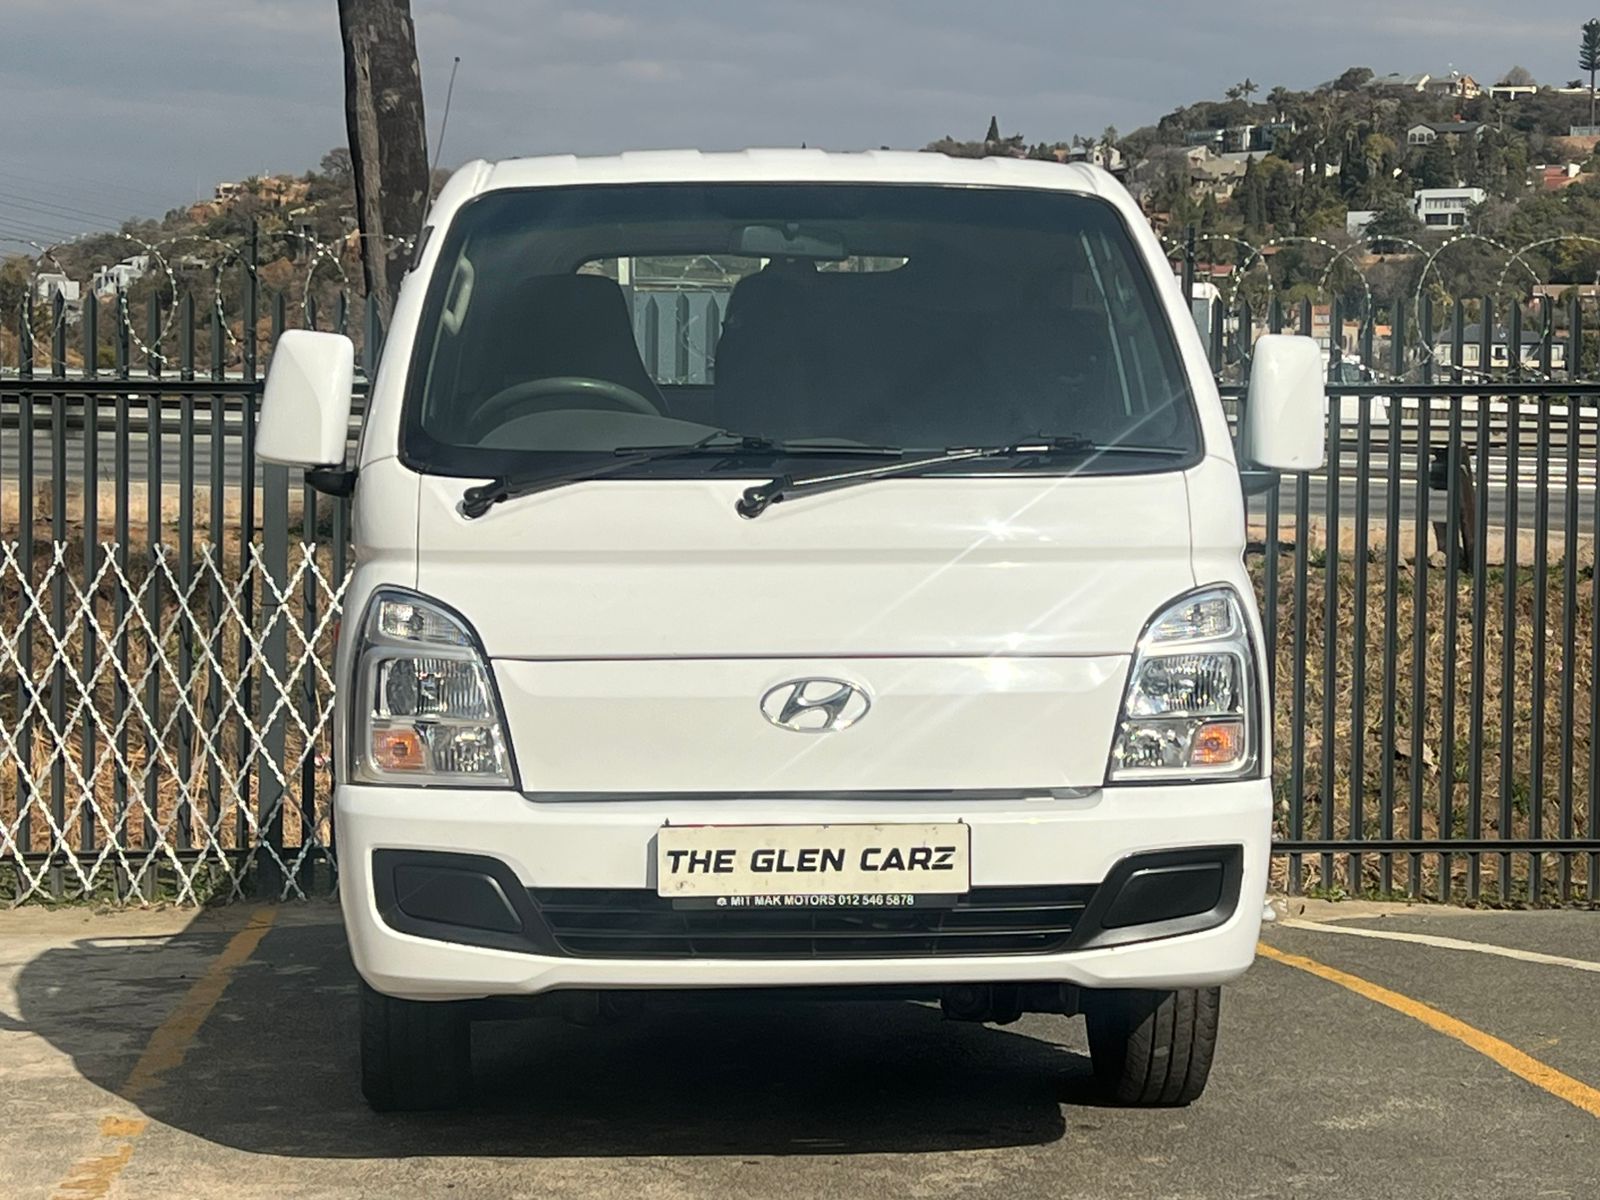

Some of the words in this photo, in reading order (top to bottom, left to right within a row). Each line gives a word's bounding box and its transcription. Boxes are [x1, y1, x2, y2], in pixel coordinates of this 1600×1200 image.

[667, 849, 736, 873] THE
[750, 848, 845, 873] GLEN
[860, 846, 956, 871] CARZ
[730, 896, 751, 906] MIT
[754, 896, 782, 906] MAK
[784, 895, 836, 905] MOTORS
[838, 894, 860, 905] 012
[862, 894, 883, 905] 546
[885, 894, 914, 905] 5878
